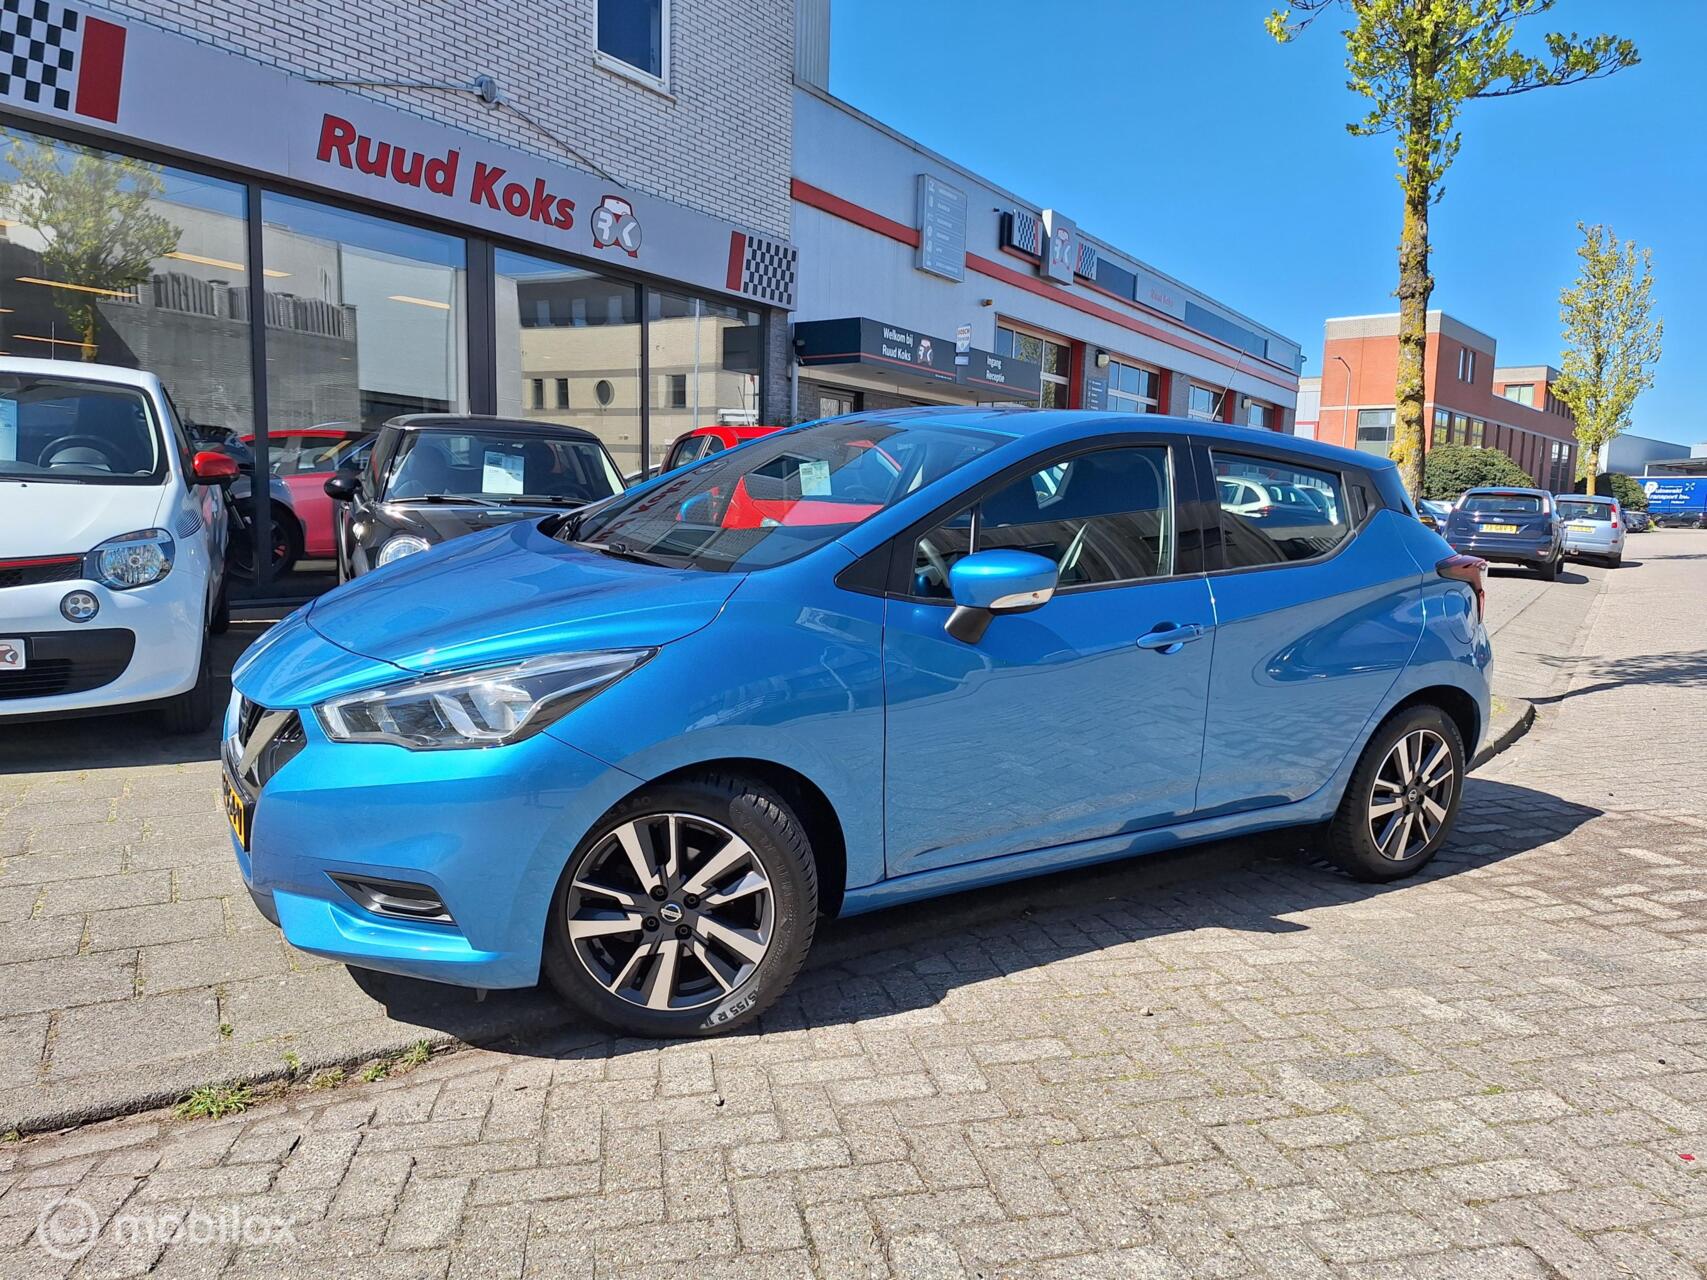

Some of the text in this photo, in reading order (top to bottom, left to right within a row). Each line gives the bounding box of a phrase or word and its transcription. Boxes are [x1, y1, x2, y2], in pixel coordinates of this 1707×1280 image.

[316, 113, 576, 230] Ruud Koks
[883, 327, 906, 343] Welkom
[882, 343, 912, 361] Ruud Koks
